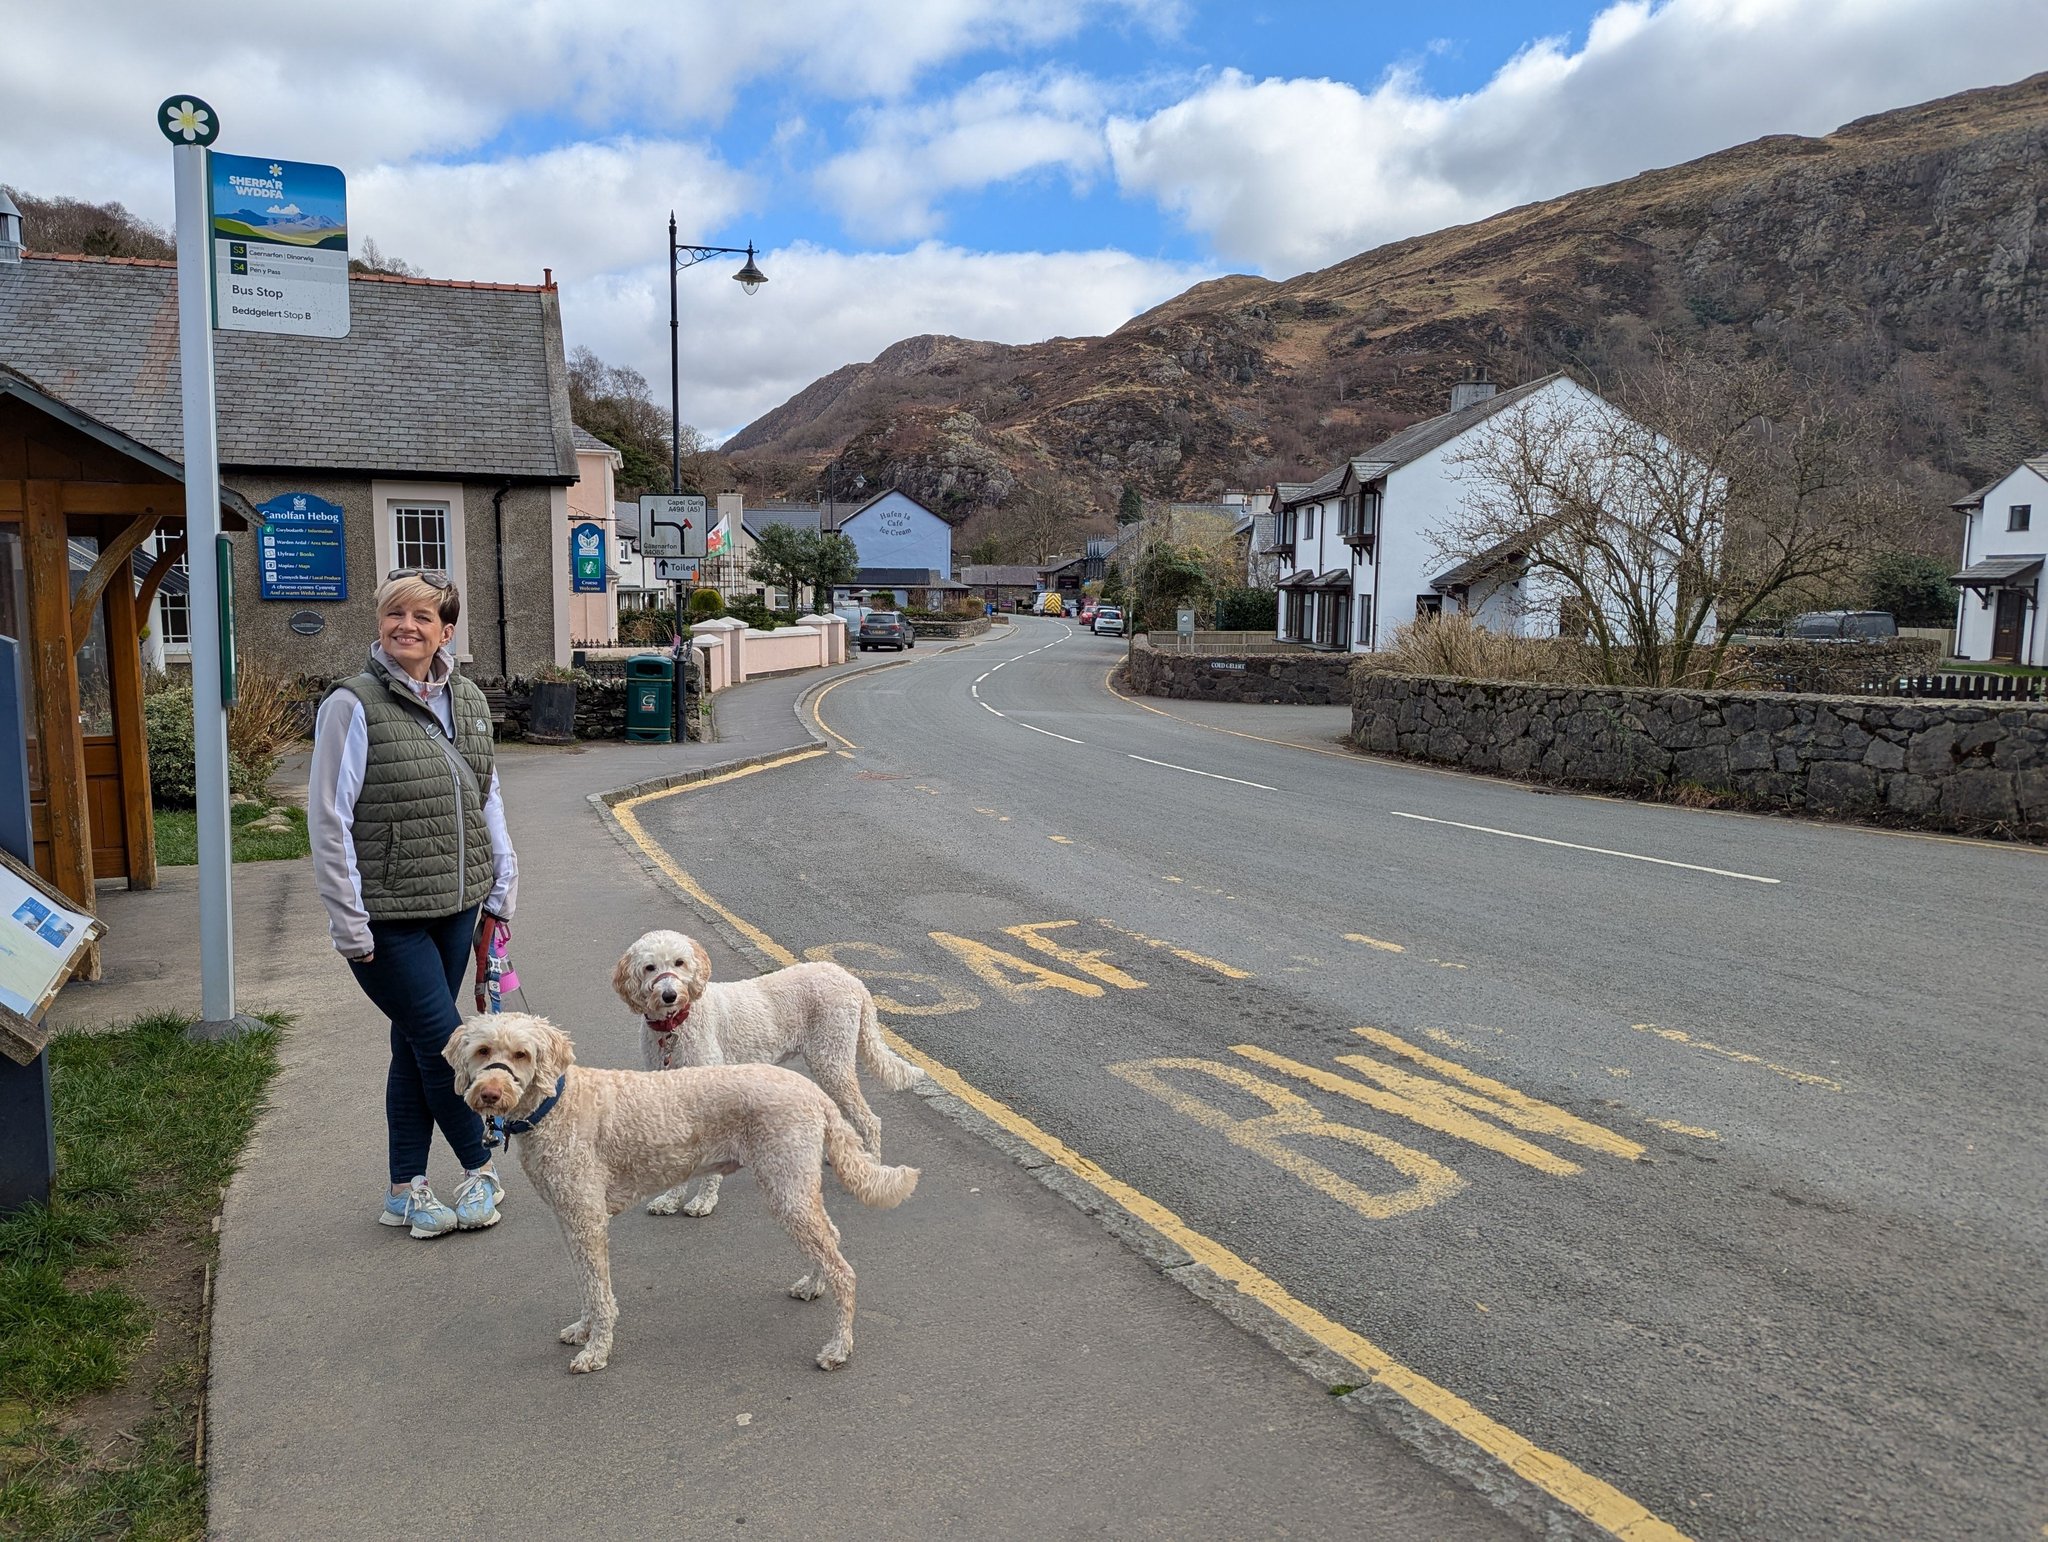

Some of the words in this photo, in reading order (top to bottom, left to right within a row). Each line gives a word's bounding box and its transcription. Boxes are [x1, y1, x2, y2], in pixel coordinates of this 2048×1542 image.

[229, 175, 283, 190] SHERPA'R
[235, 186, 284, 199] WYDDFA
[233, 246, 244, 254] S3
[249, 250, 283, 258] Caernarfon
[287, 254, 314, 262] Dinorwig
[234, 263, 245, 271] S4
[232, 285, 254, 296] Bus
[257, 286, 283, 300] Stop
[232, 306, 282, 318] Beddgelert
[284, 307, 304, 320] Stop
[305, 309, 311, 320] B
[262, 510, 305, 520] Canolfan
[308, 512, 339, 523] Hebog
[880, 510, 902, 520] Hufen
[879, 526, 889, 535] Ice
[890, 528, 912, 536] Cream
[670, 563, 696, 571] Toiled
